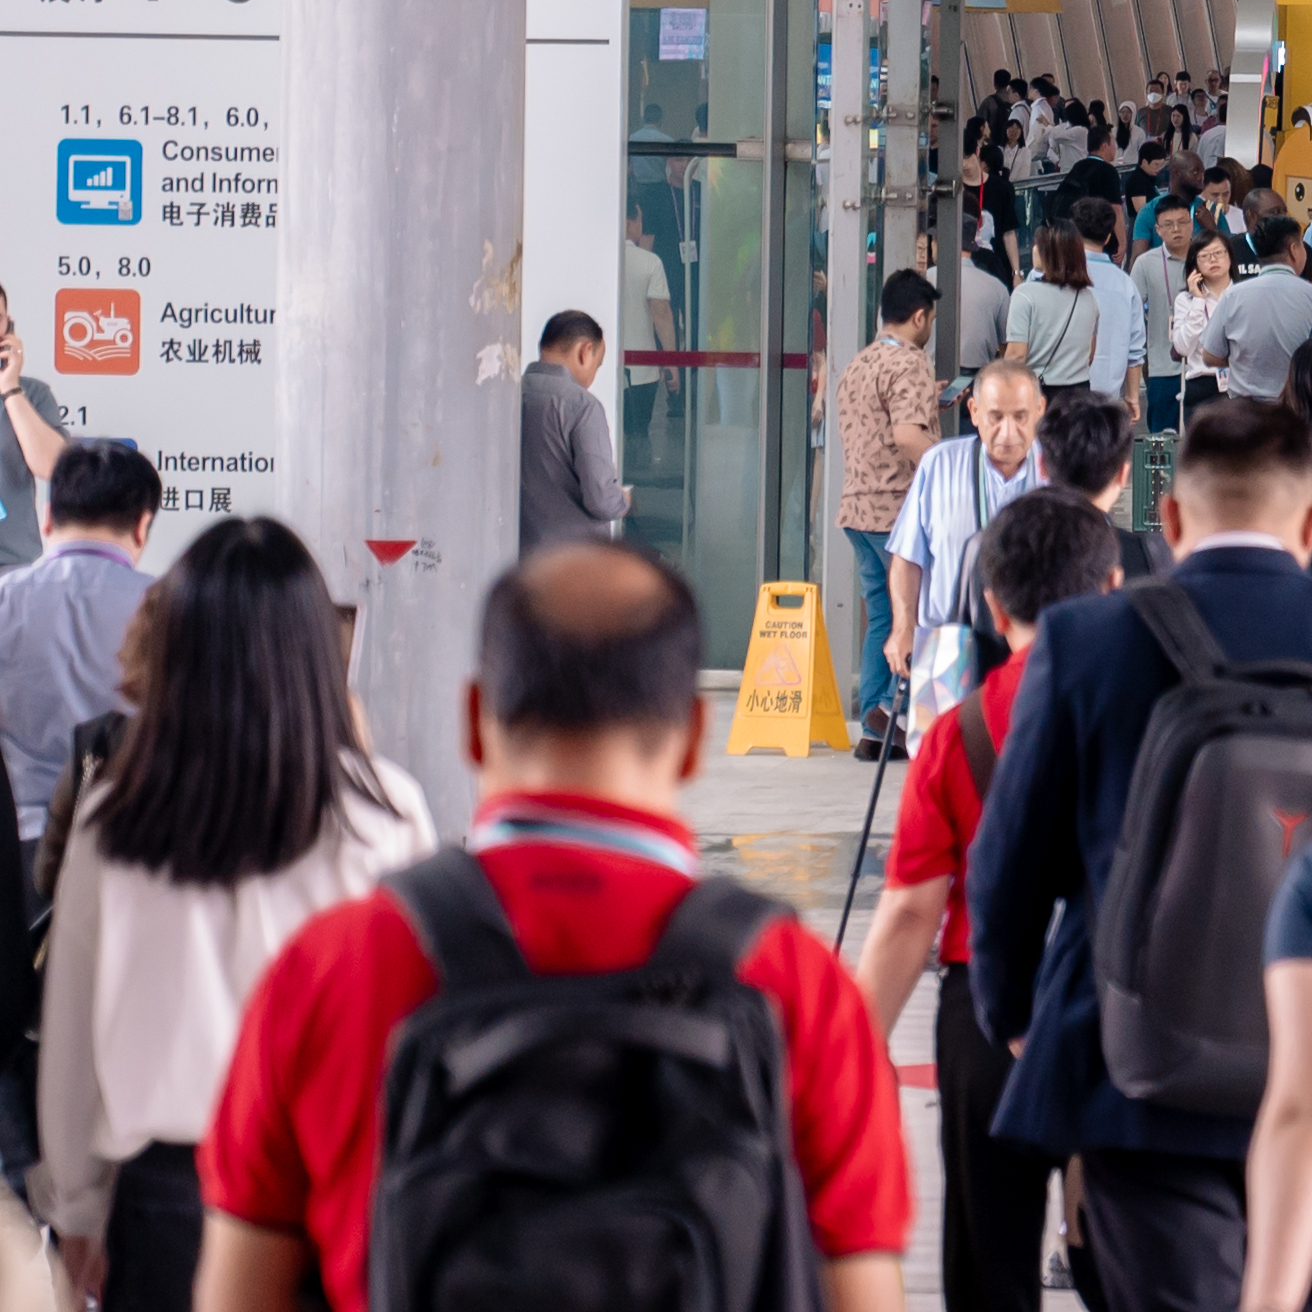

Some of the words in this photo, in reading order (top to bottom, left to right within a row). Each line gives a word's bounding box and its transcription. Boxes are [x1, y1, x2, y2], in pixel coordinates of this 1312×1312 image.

[61, 105, 101, 127] 1.1,
[227, 107, 267, 130] 6.0,
[162, 172, 204, 192] and
[59, 256, 99, 279] 5.0,
[119, 257, 150, 276] 8.0
[160, 338, 261, 364] 农业机械
[161, 488, 231, 512] 进口展
[765, 621, 803, 629] CAUTION
[780, 631, 807, 639] FLOOR
[746, 689, 802, 713] 小心地滑
